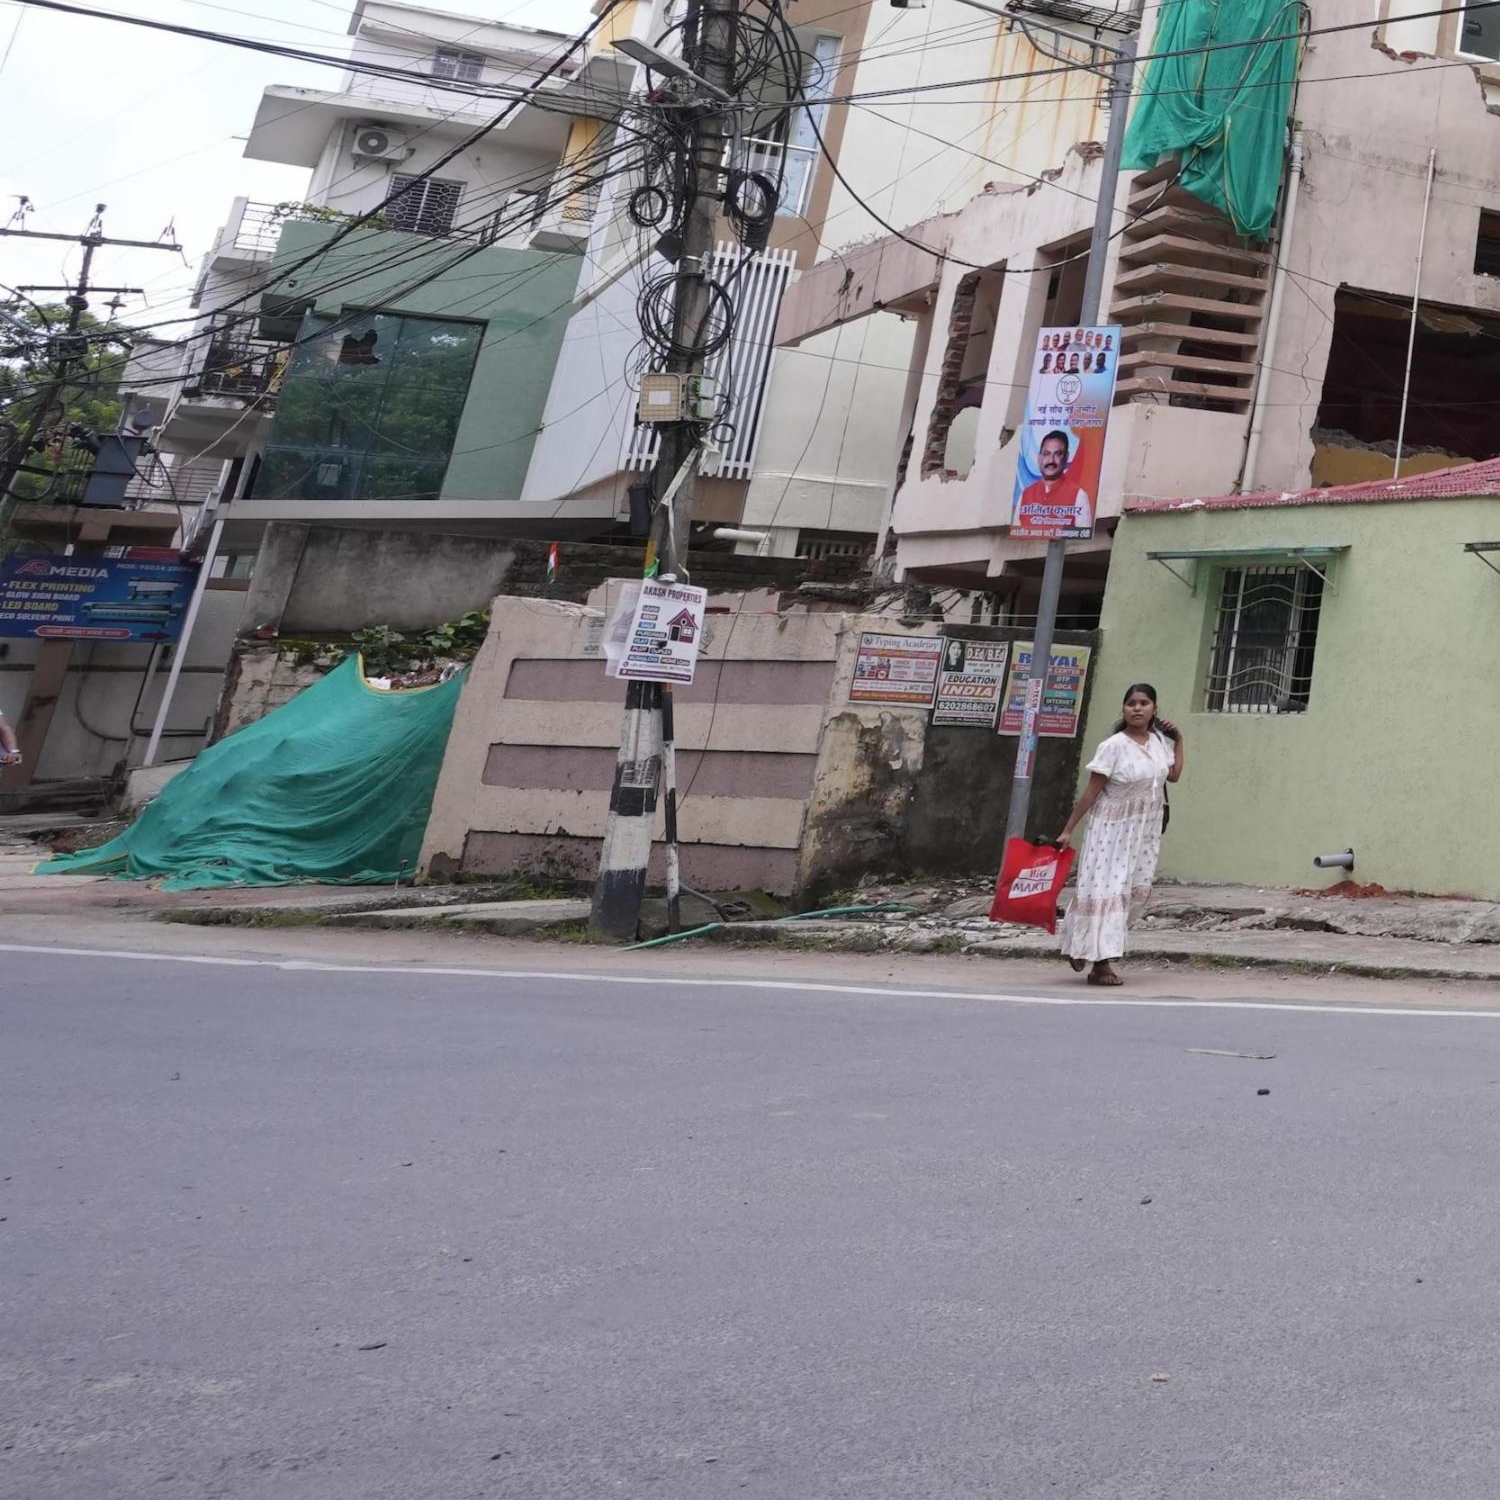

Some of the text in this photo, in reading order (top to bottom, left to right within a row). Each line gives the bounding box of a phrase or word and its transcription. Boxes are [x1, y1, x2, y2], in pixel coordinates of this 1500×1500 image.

[1020, 503, 1083, 518] अमित कुमार
[49, 566, 109, 578] MEDIA
[9, 581, 96, 593] FLEX PRINTING
[5, 591, 30, 599] GLOW
[643, 585, 703, 604] AKASH PROPERTIES
[2, 601, 59, 611] LED BOARD
[16, 613, 51, 621] SOLVENT
[52, 614, 76, 622] PRINT
[875, 636, 937, 649] Typing Academy
[1018, 652, 1079, 667] RYAL
[947, 675, 997, 685] EDUCATION
[941, 685, 993, 698] INDIA
[1012, 882, 1046, 893] MART
